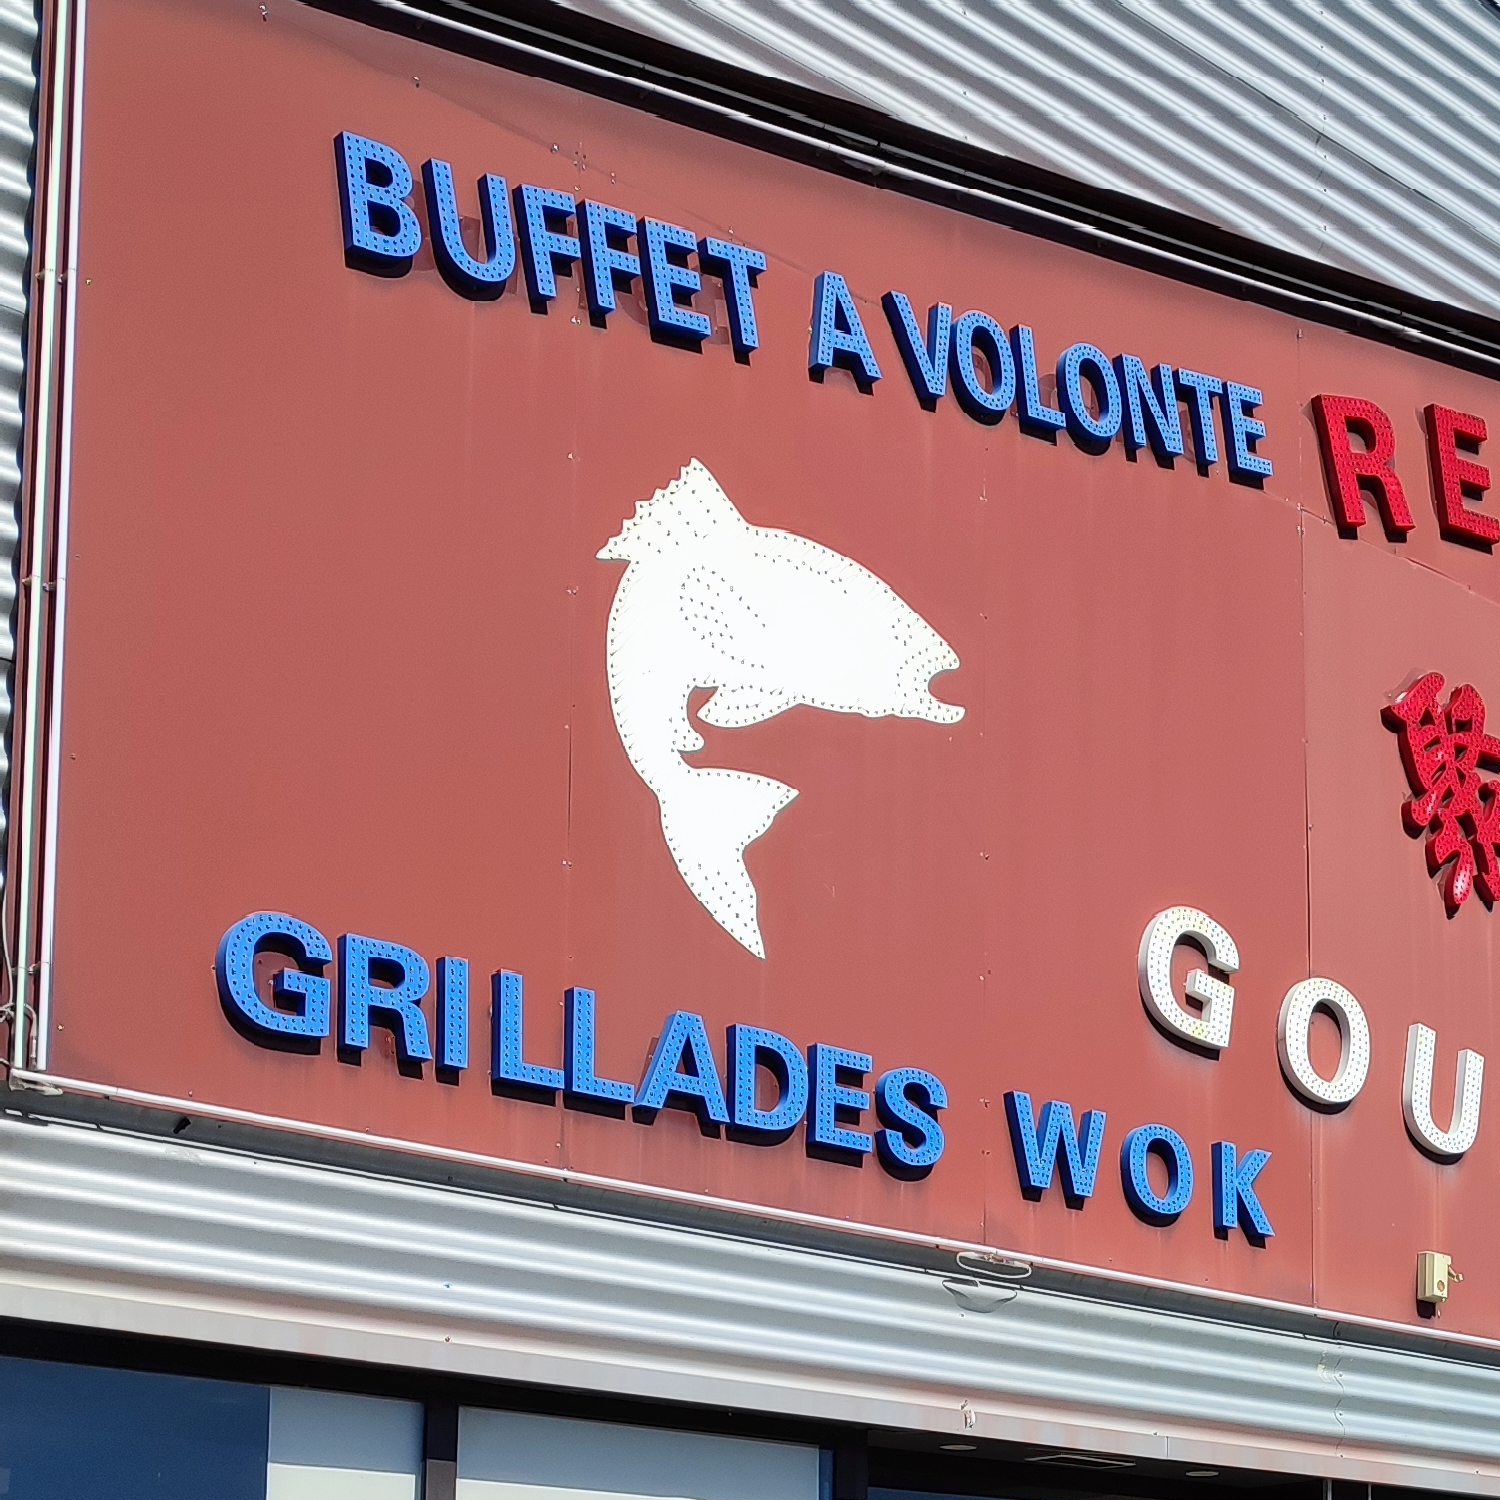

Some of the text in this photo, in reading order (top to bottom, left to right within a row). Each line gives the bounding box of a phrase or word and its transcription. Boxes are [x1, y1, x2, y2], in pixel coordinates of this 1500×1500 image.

[334, 131, 1273, 477] BUFFET A VOLONTE
[216, 912, 1273, 1237] GRILLADES WOK
